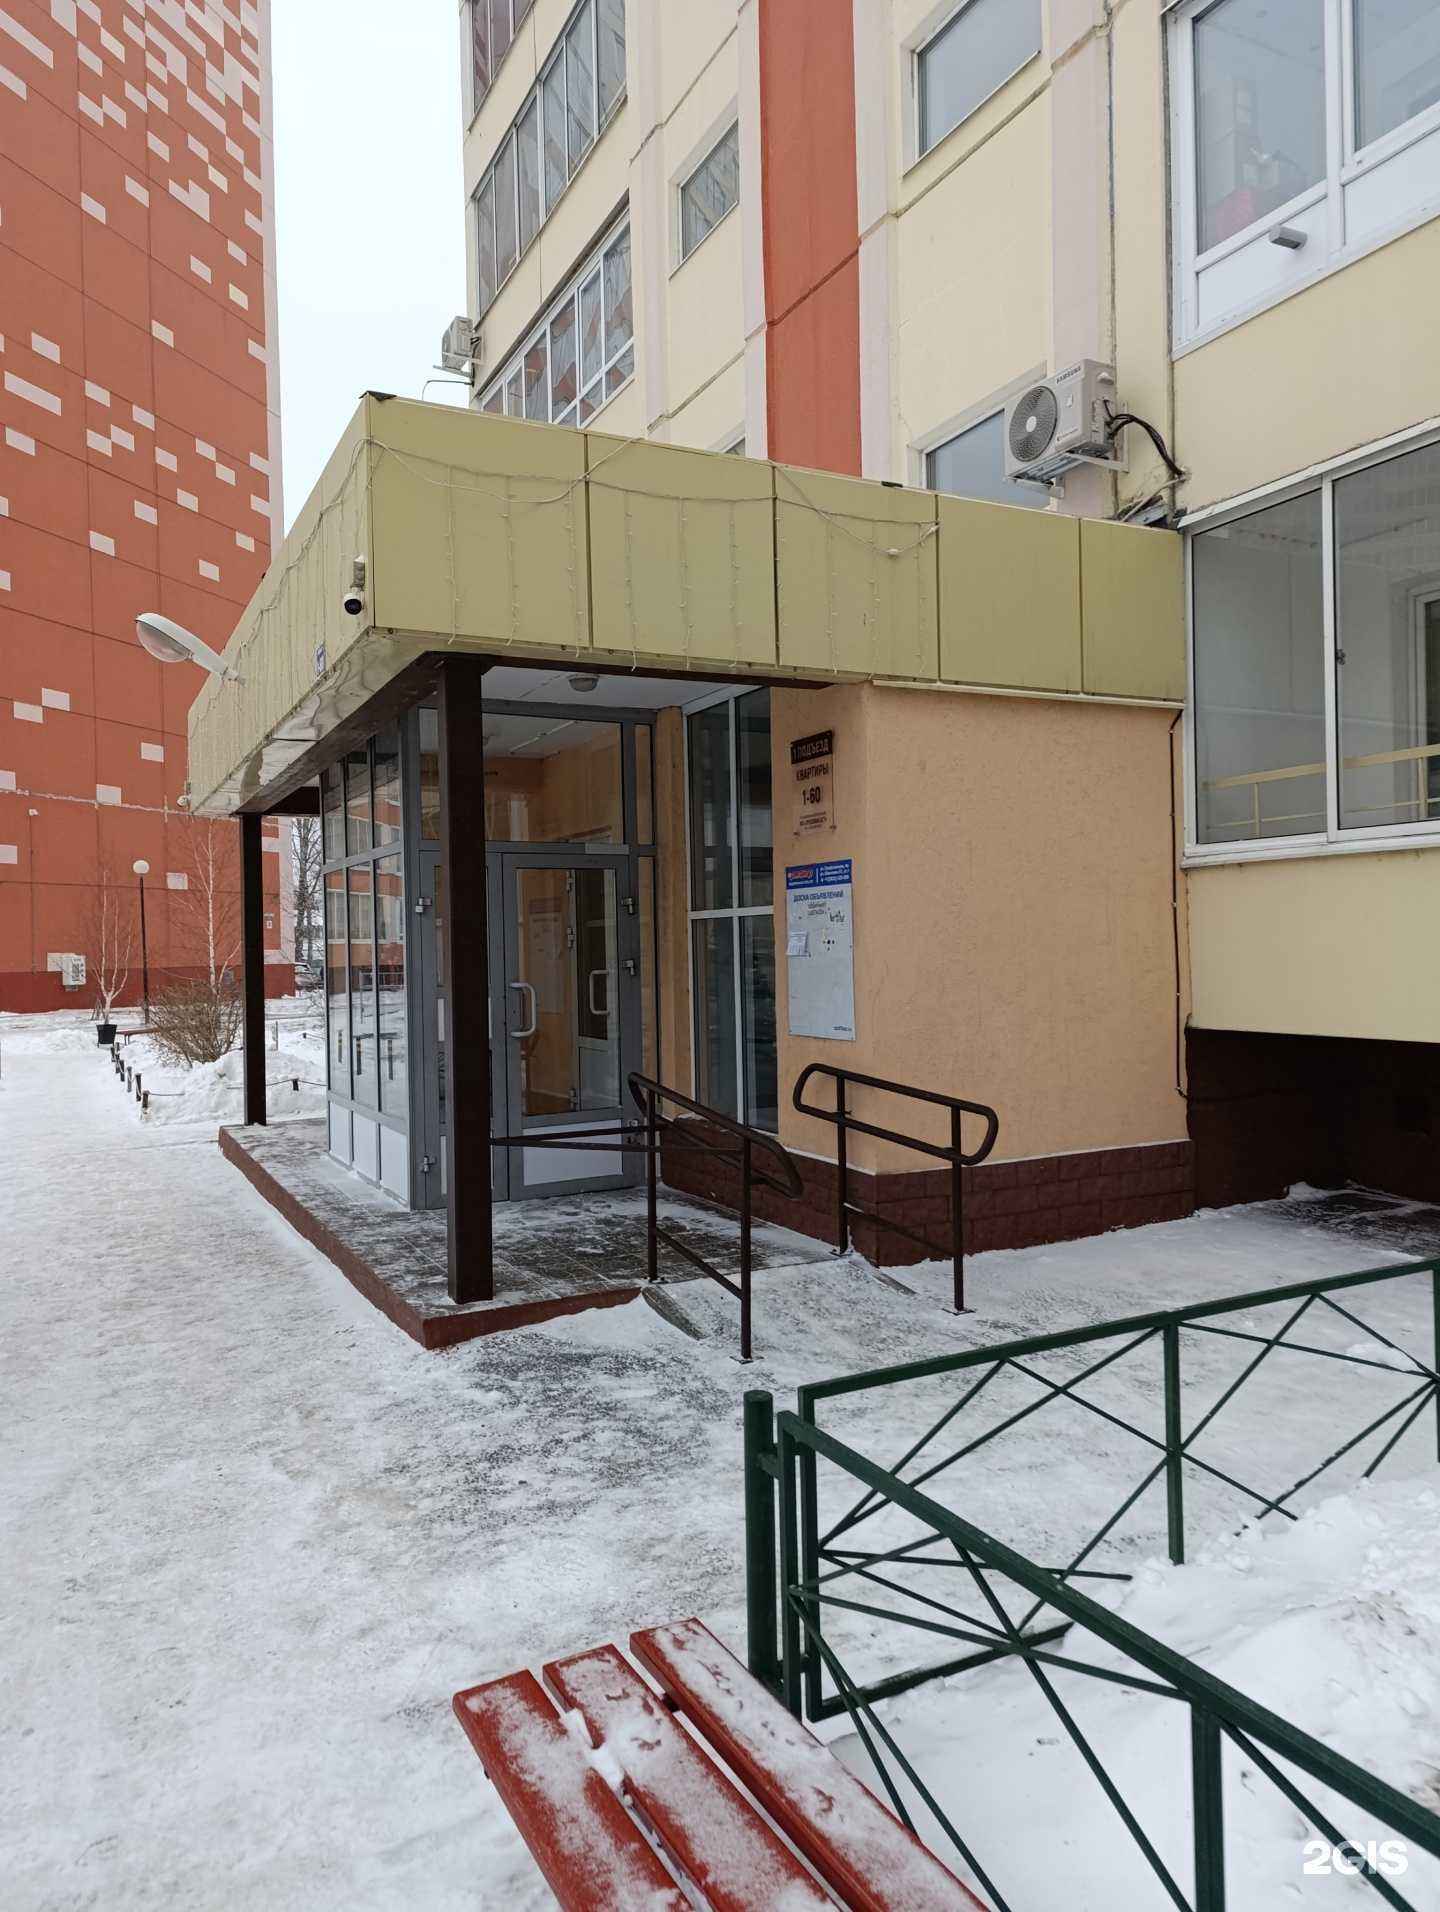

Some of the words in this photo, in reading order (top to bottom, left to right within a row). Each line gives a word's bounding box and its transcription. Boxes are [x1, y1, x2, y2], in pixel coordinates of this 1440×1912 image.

[797, 738, 829, 760] ПОДЪЕЗД
[796, 763, 829, 781] КВАРТИРЫ
[802, 786, 821, 805] 1-60
